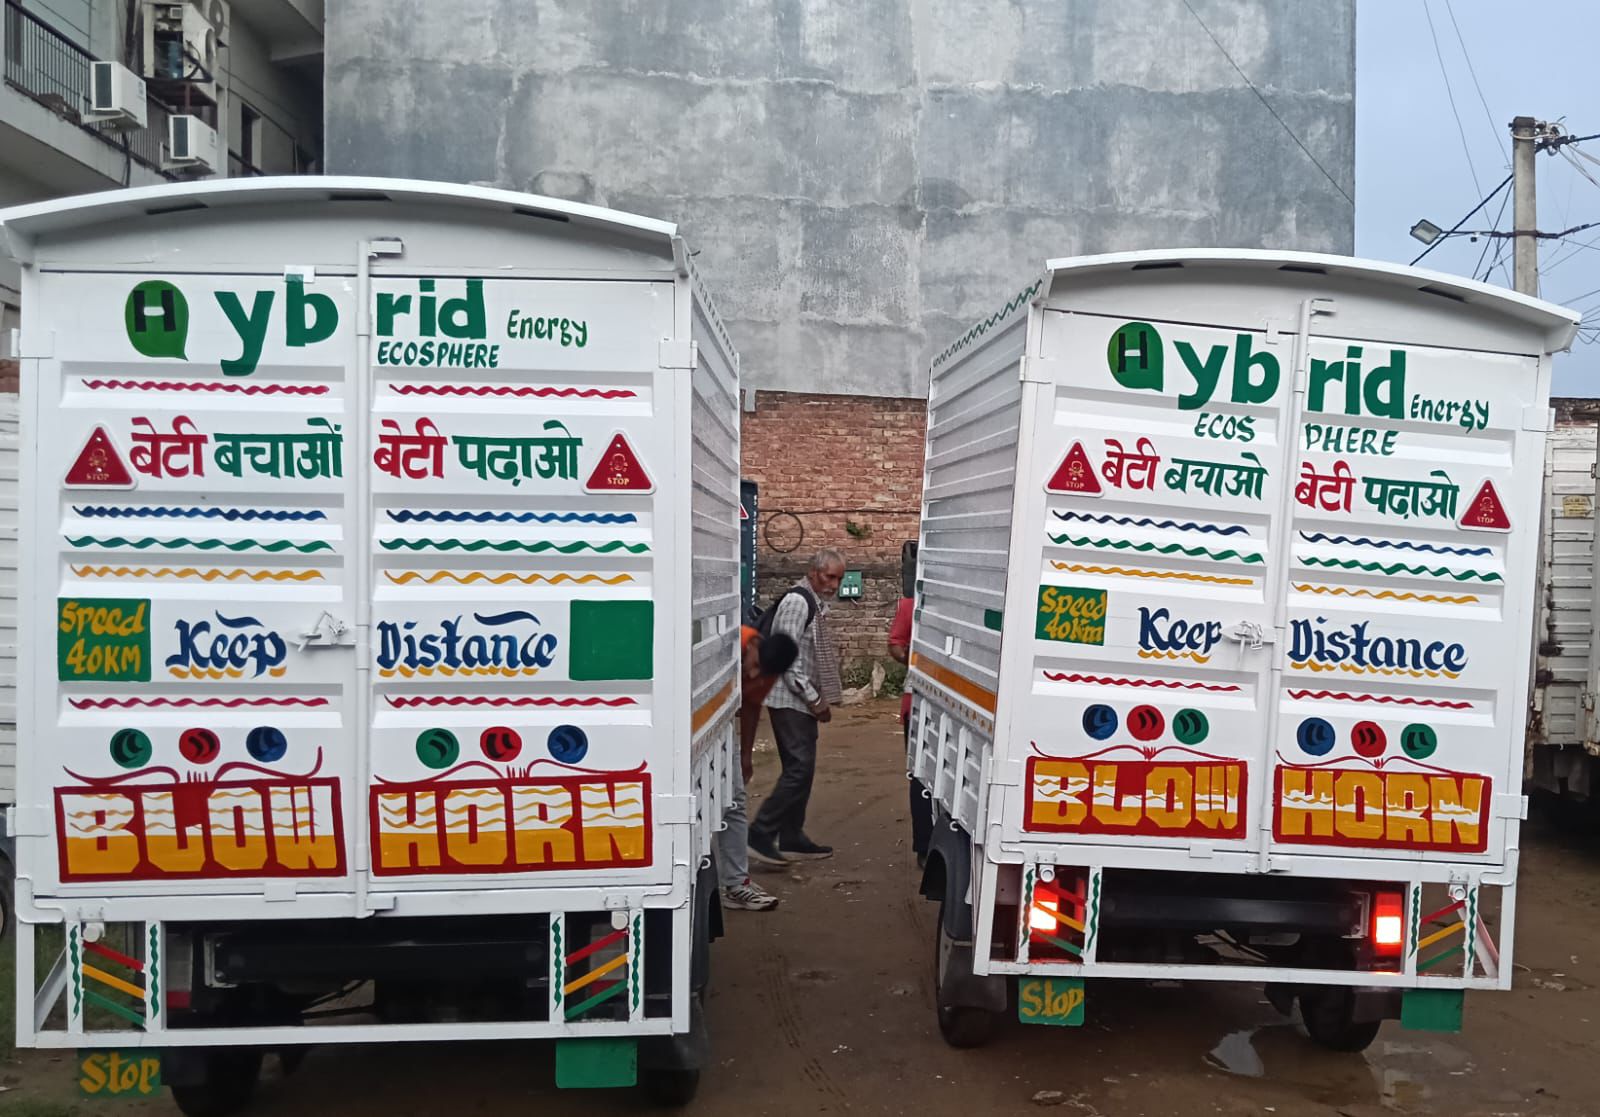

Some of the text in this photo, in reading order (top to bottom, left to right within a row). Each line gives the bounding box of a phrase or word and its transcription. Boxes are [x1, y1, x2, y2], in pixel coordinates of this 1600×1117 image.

[507, 309, 588, 348] Energy
[377, 340, 500, 369] ECOSPHERE
[1410, 394, 1490, 434] Energy
[129, 415, 209, 480] बेटी
[373, 416, 449, 480] बेटी
[451, 419, 584, 487] पढ़ाओ
[86, 472, 110, 481] STOP
[607, 477, 630, 486] STOP
[1065, 480, 1085, 489] STOP
[1101, 437, 1461, 520] बेटी बचाओ बेटी पढ़ाओ
[1476, 515, 1495, 524] STOP
[60, 601, 146, 637] Speed
[1040, 586, 1107, 621] Speed
[165, 610, 558, 679] Keep Distance
[1137, 606, 1469, 673] Keep Distance
[1031, 759, 1485, 848] BLOW HORN
[63, 781, 645, 876] BLOW HORN
[1021, 979, 1085, 1020] Stop
[80, 1051, 160, 1095] Stop
